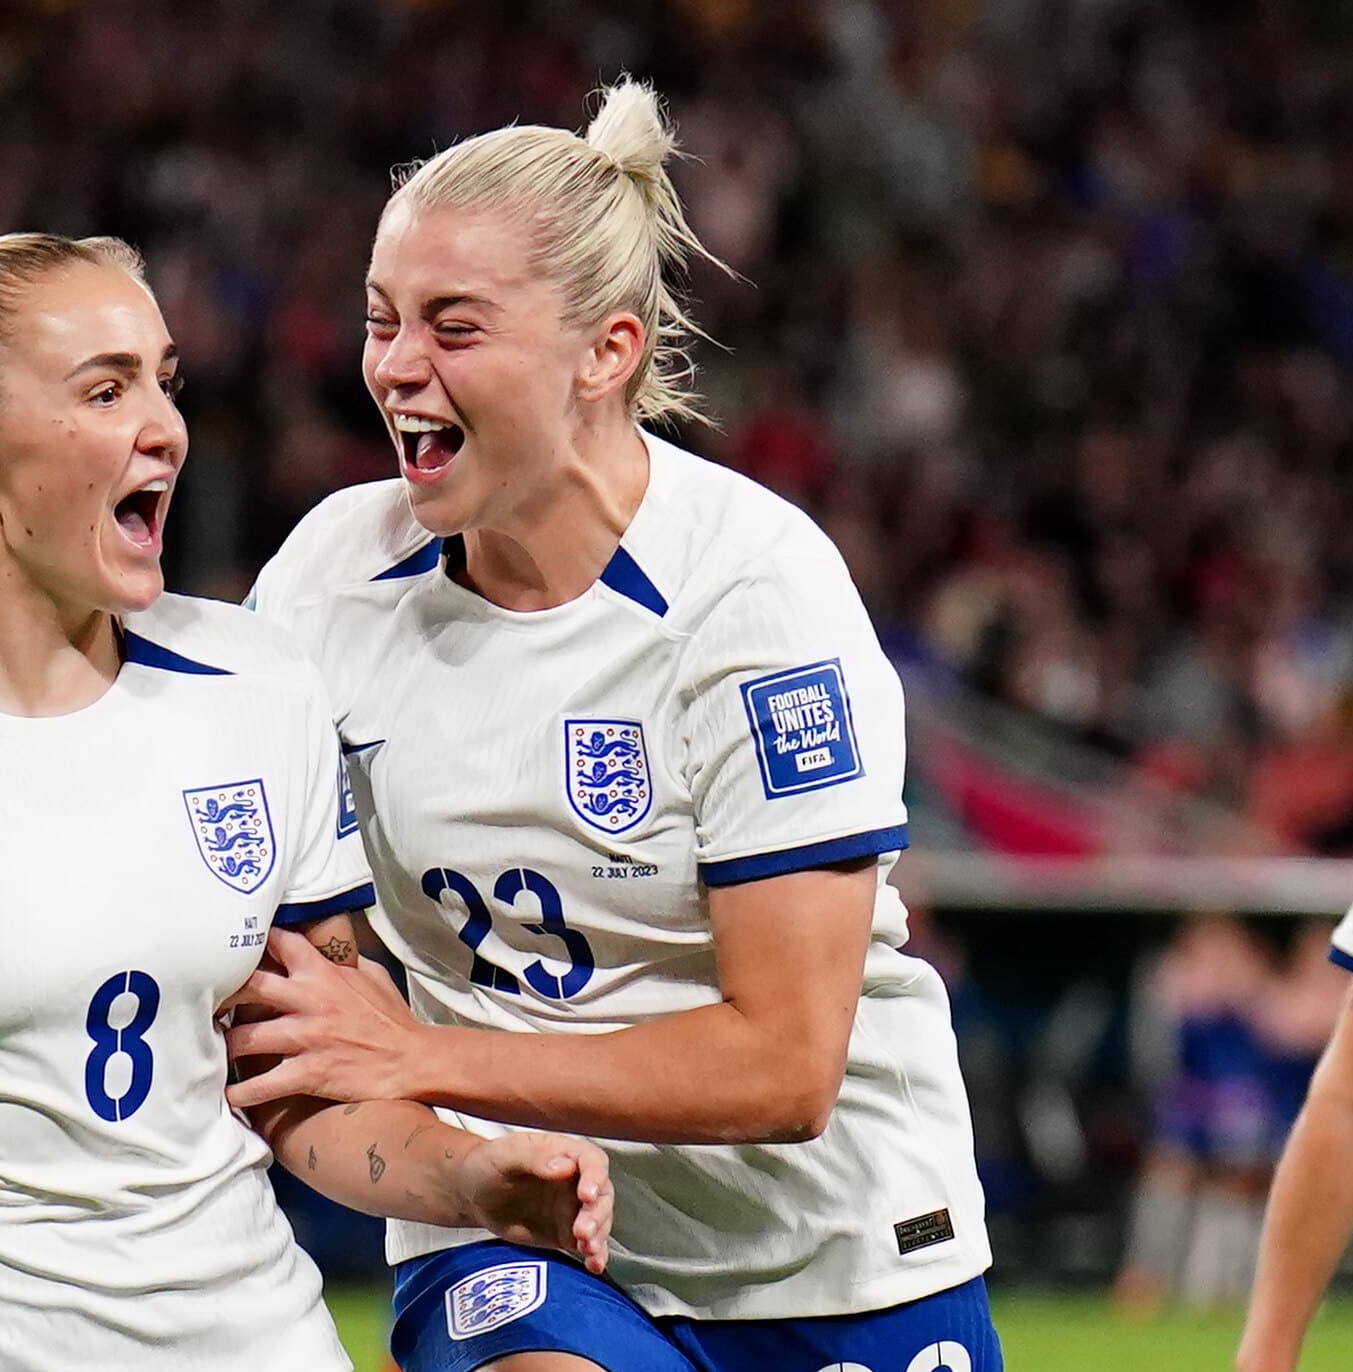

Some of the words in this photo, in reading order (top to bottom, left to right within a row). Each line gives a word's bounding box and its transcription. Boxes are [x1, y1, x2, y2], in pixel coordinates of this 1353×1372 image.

[768, 683, 830, 713] FOOTBALL
[772, 700, 834, 734] UNITES
[773, 733, 800, 754] the
[799, 721, 840, 749] World
[802, 753, 826, 766] FIFA
[592, 866, 604, 878] 22
[607, 867, 628, 879] JULY
[631, 864, 658, 878] 2023
[421, 867, 595, 999] 23
[85, 970, 160, 1122] 8
